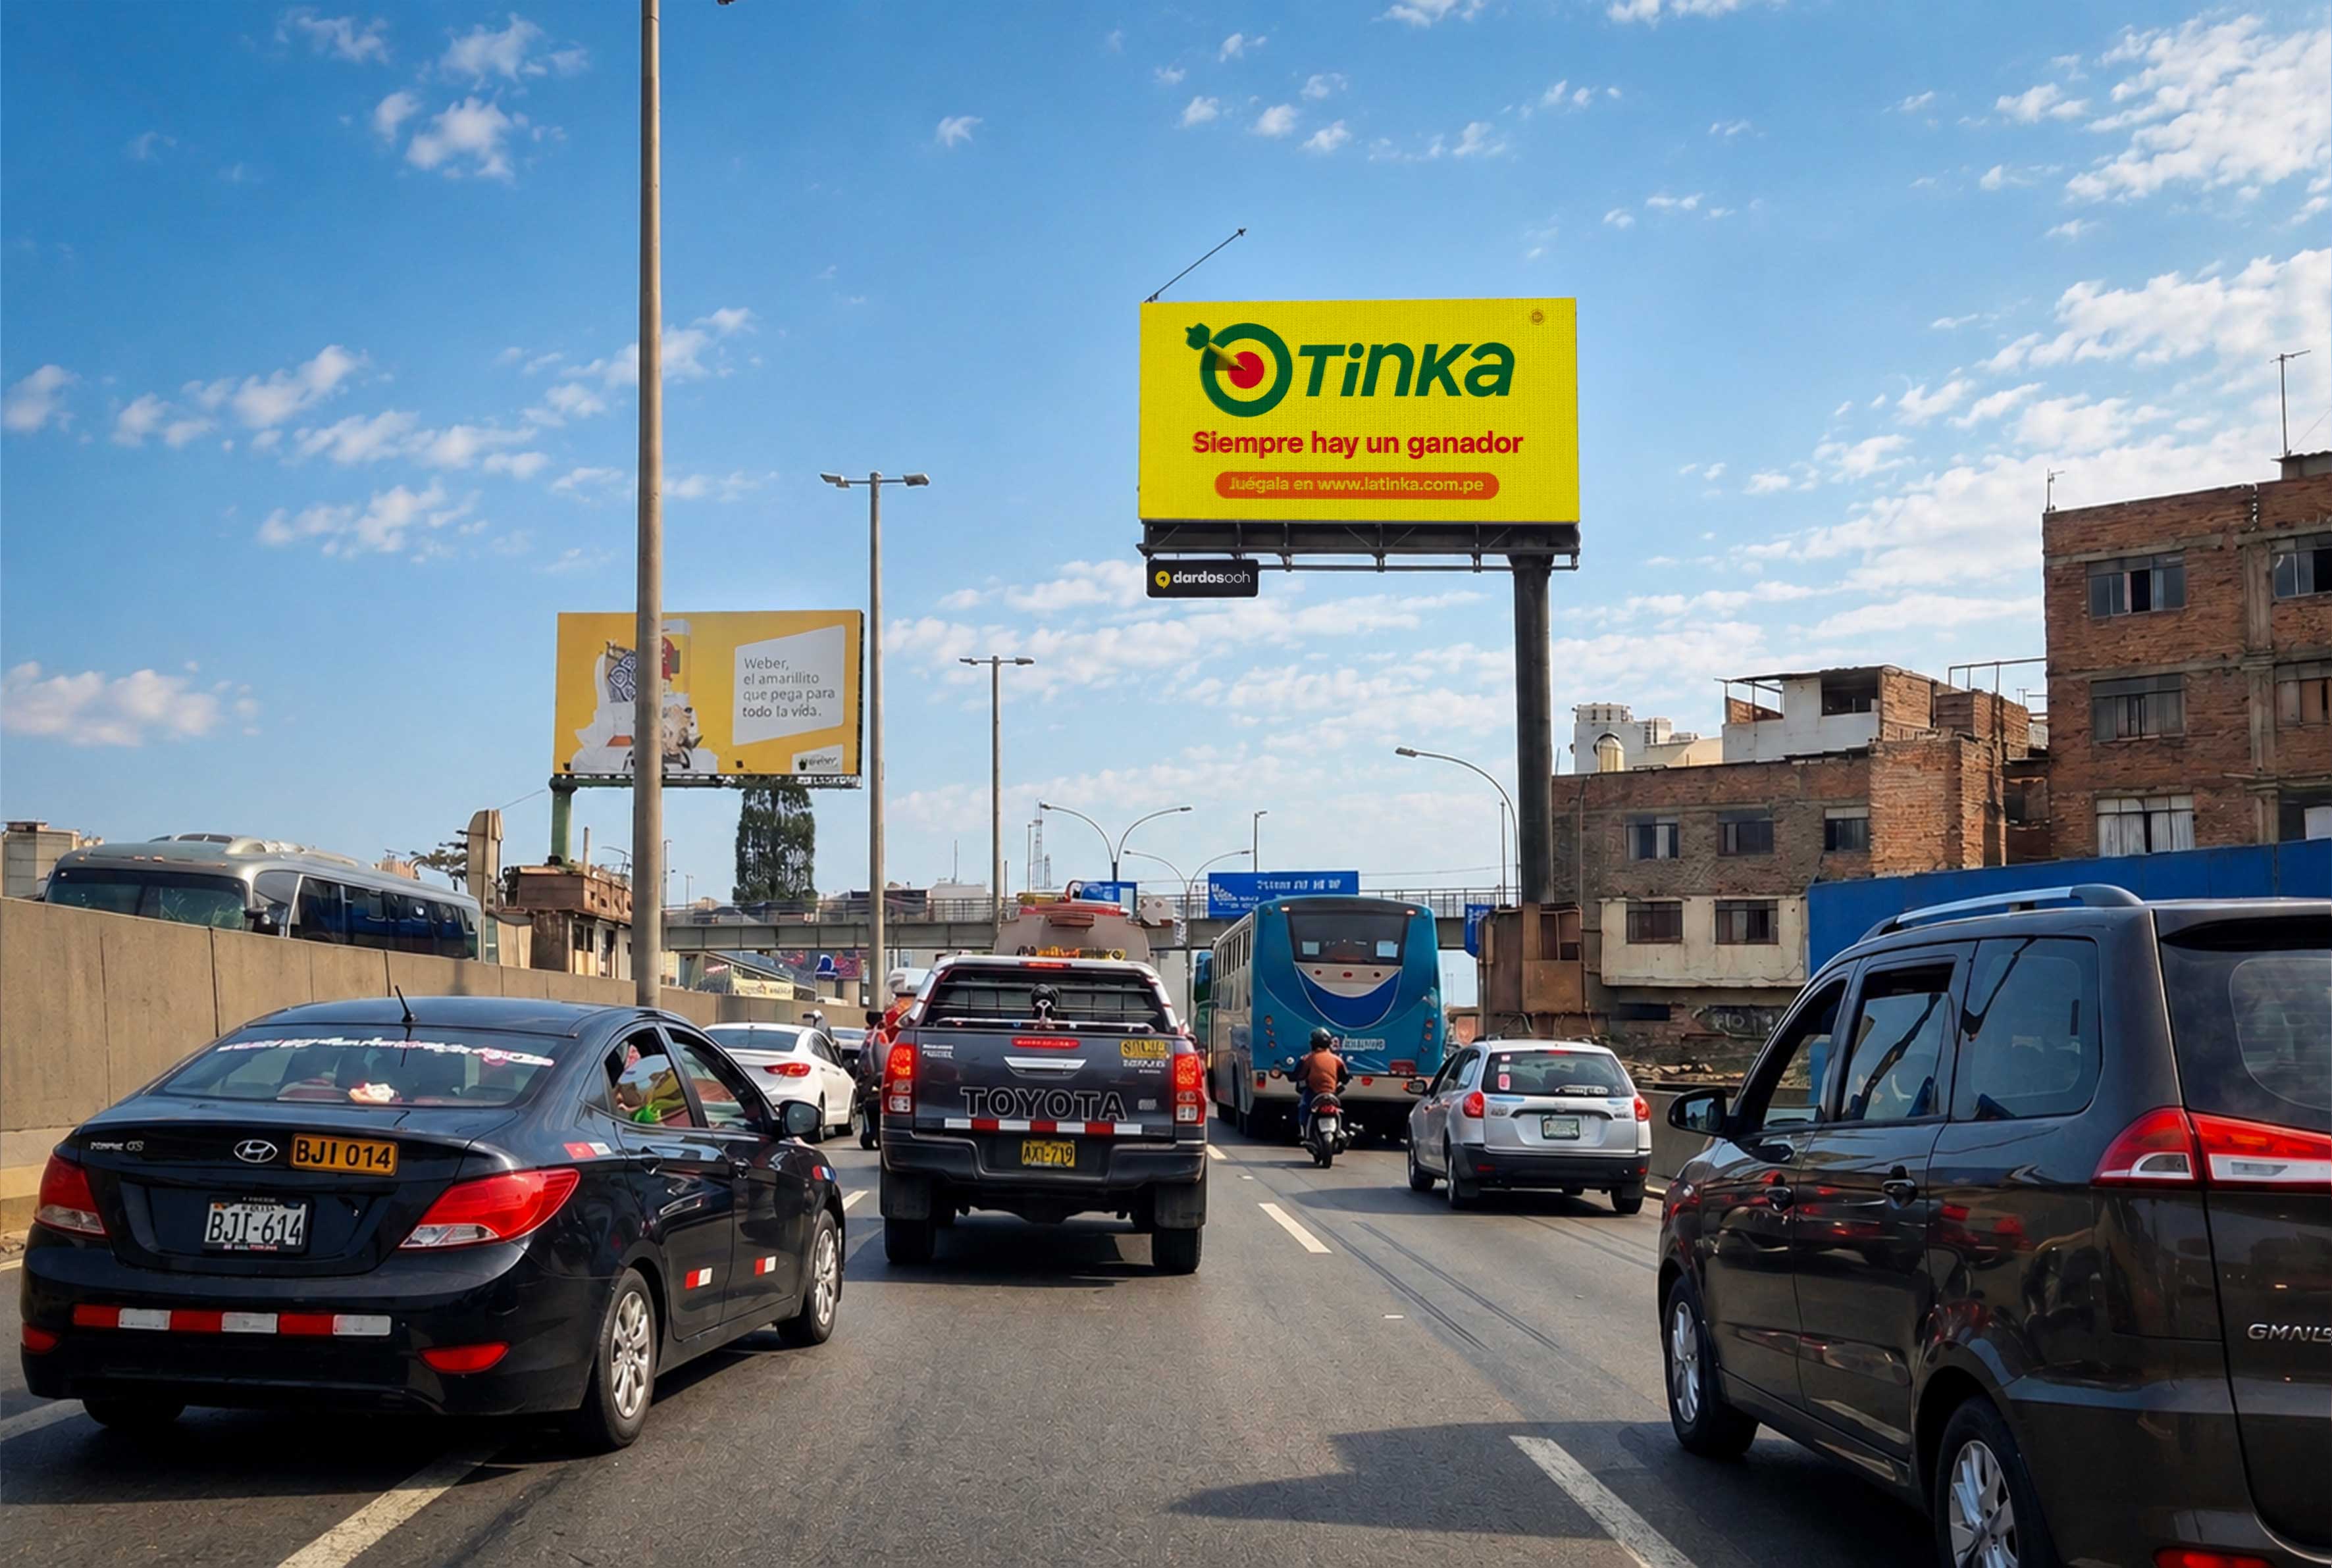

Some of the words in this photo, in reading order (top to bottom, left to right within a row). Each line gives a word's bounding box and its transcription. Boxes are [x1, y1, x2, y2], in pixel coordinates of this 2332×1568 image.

[1192, 430, 1304, 459] Siempre
[1311, 430, 1359, 459] hay
[1366, 436, 1399, 453] un
[1407, 430, 1524, 460] ganador
[1228, 476, 1289, 493] Juégala
[1293, 479, 1313, 490] en
[1318, 476, 1484, 494] www.latinka.com.pe
[1172, 570, 1251, 584] dardosooh
[744, 657, 789, 670] Weber,
[743, 672, 755, 685] el
[758, 670, 819, 685] amarillito
[743, 691, 767, 703] que
[770, 690, 803, 703] pega
[806, 689, 836, 703] para
[742, 705, 772, 718] todo
[776, 705, 789, 718] la
[960, 1086, 1127, 1122] TOYOTA
[296, 1138, 338, 1165] BJI
[345, 1144, 392, 1169] 014
[208, 1211, 301, 1245] BJI-614
